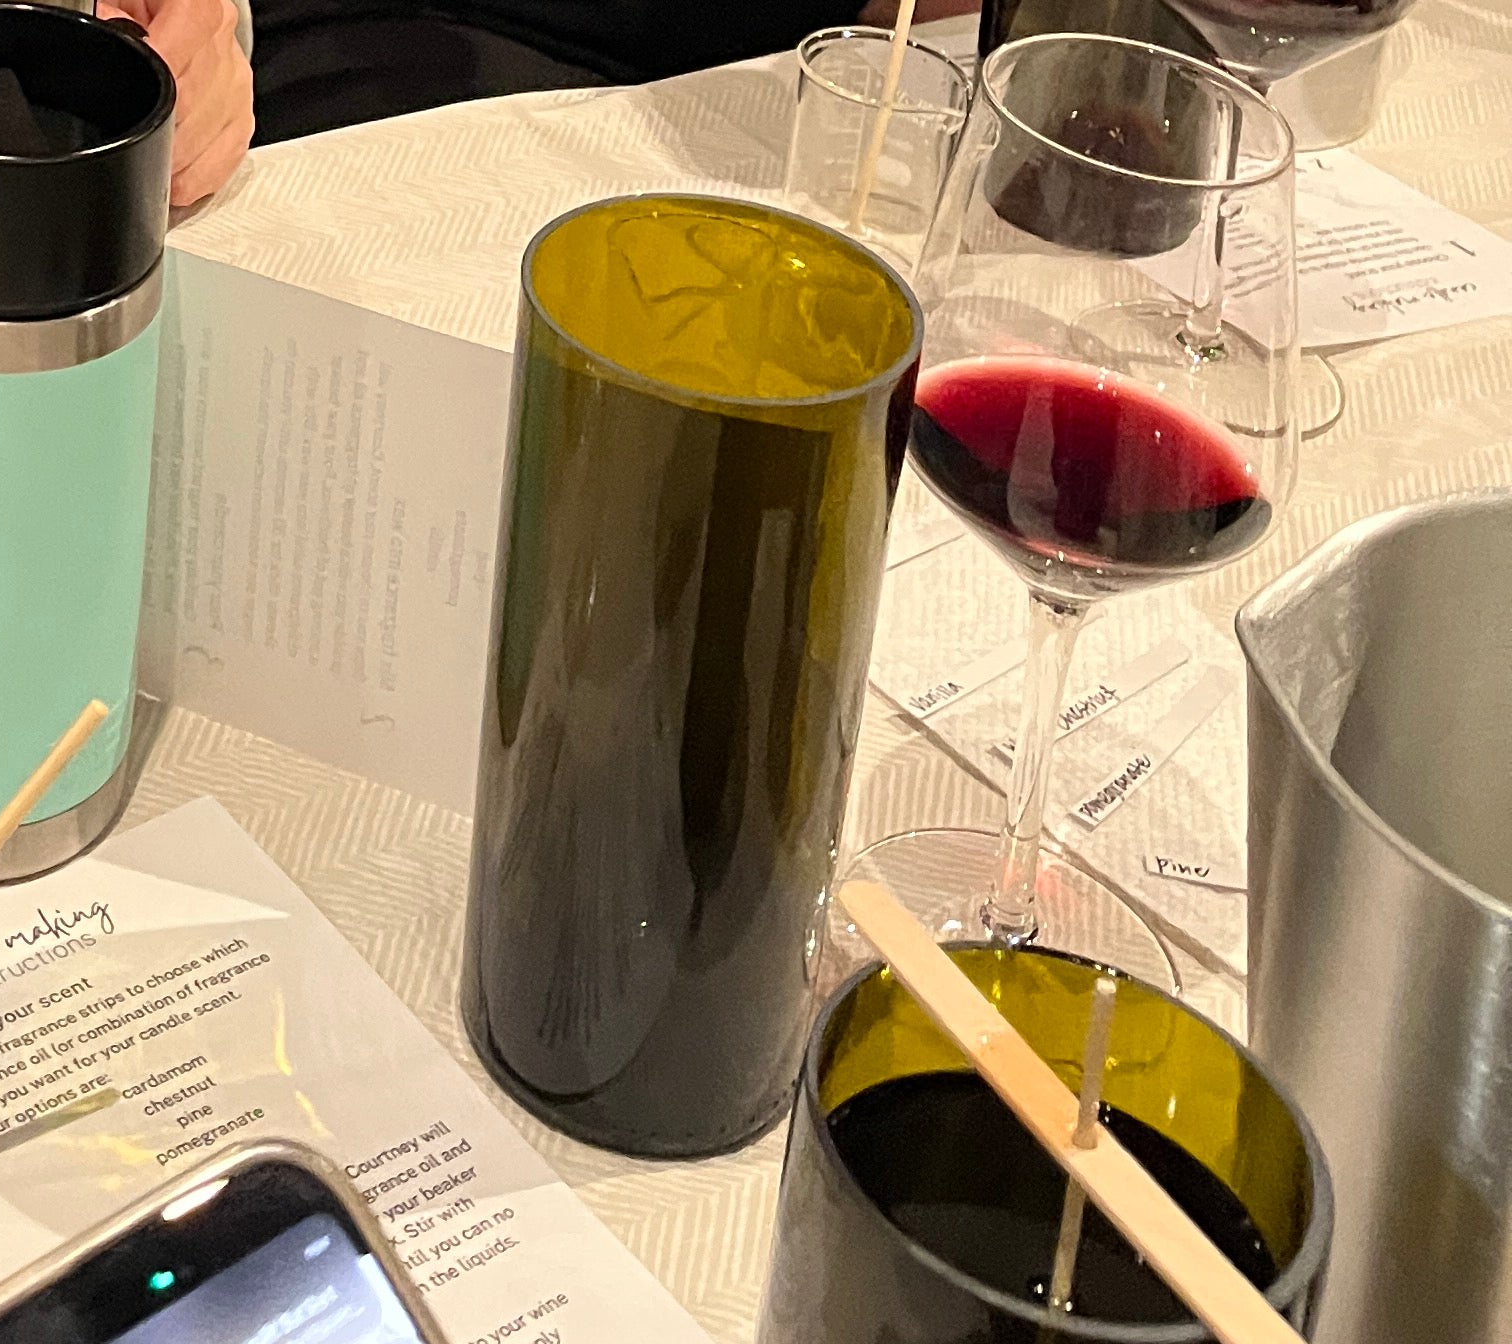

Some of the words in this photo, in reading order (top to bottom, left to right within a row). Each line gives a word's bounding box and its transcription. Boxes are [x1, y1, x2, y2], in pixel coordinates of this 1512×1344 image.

[4, 901, 115, 949] making
[38, 976, 94, 1009] scent
[77, 992, 126, 1019] strips
[125, 984, 145, 998] to
[146, 959, 202, 990] choose
[200, 937, 249, 964] which
[29, 1046, 52, 1066] oil
[51, 1037, 76, 1058] (or
[77, 994, 176, 1044] combination
[176, 983, 194, 1001] of
[194, 952, 271, 990] fragrance
[29, 1064, 73, 1090] want
[73, 1053, 99, 1071] for
[99, 1036, 136, 1061] your
[138, 1011, 193, 1042] candle
[14, 1087, 78, 1123] options
[79, 1072, 113, 1095] are:
[122, 1053, 209, 1100] cardamom
[143, 1075, 217, 1117] chestnut
[155, 1107, 265, 1166] pomegranate
[176, 1103, 214, 1129] pine
[344, 1137, 419, 1179] Courtney
[419, 1120, 451, 1142] will
[419, 1153, 441, 1172] oil
[441, 1138, 472, 1162] and
[383, 1195, 420, 1223] your
[418, 1166, 477, 1201] beaker
[404, 1217, 435, 1238] Stir
[437, 1198, 475, 1221] with
[429, 1236, 461, 1260] you
[462, 1214, 494, 1240] can
[493, 1207, 515, 1230] no
[429, 1267, 460, 1287] the
[460, 1234, 521, 1271] liquids.
[487, 1315, 526, 1344] your
[527, 1293, 569, 1320] wine
